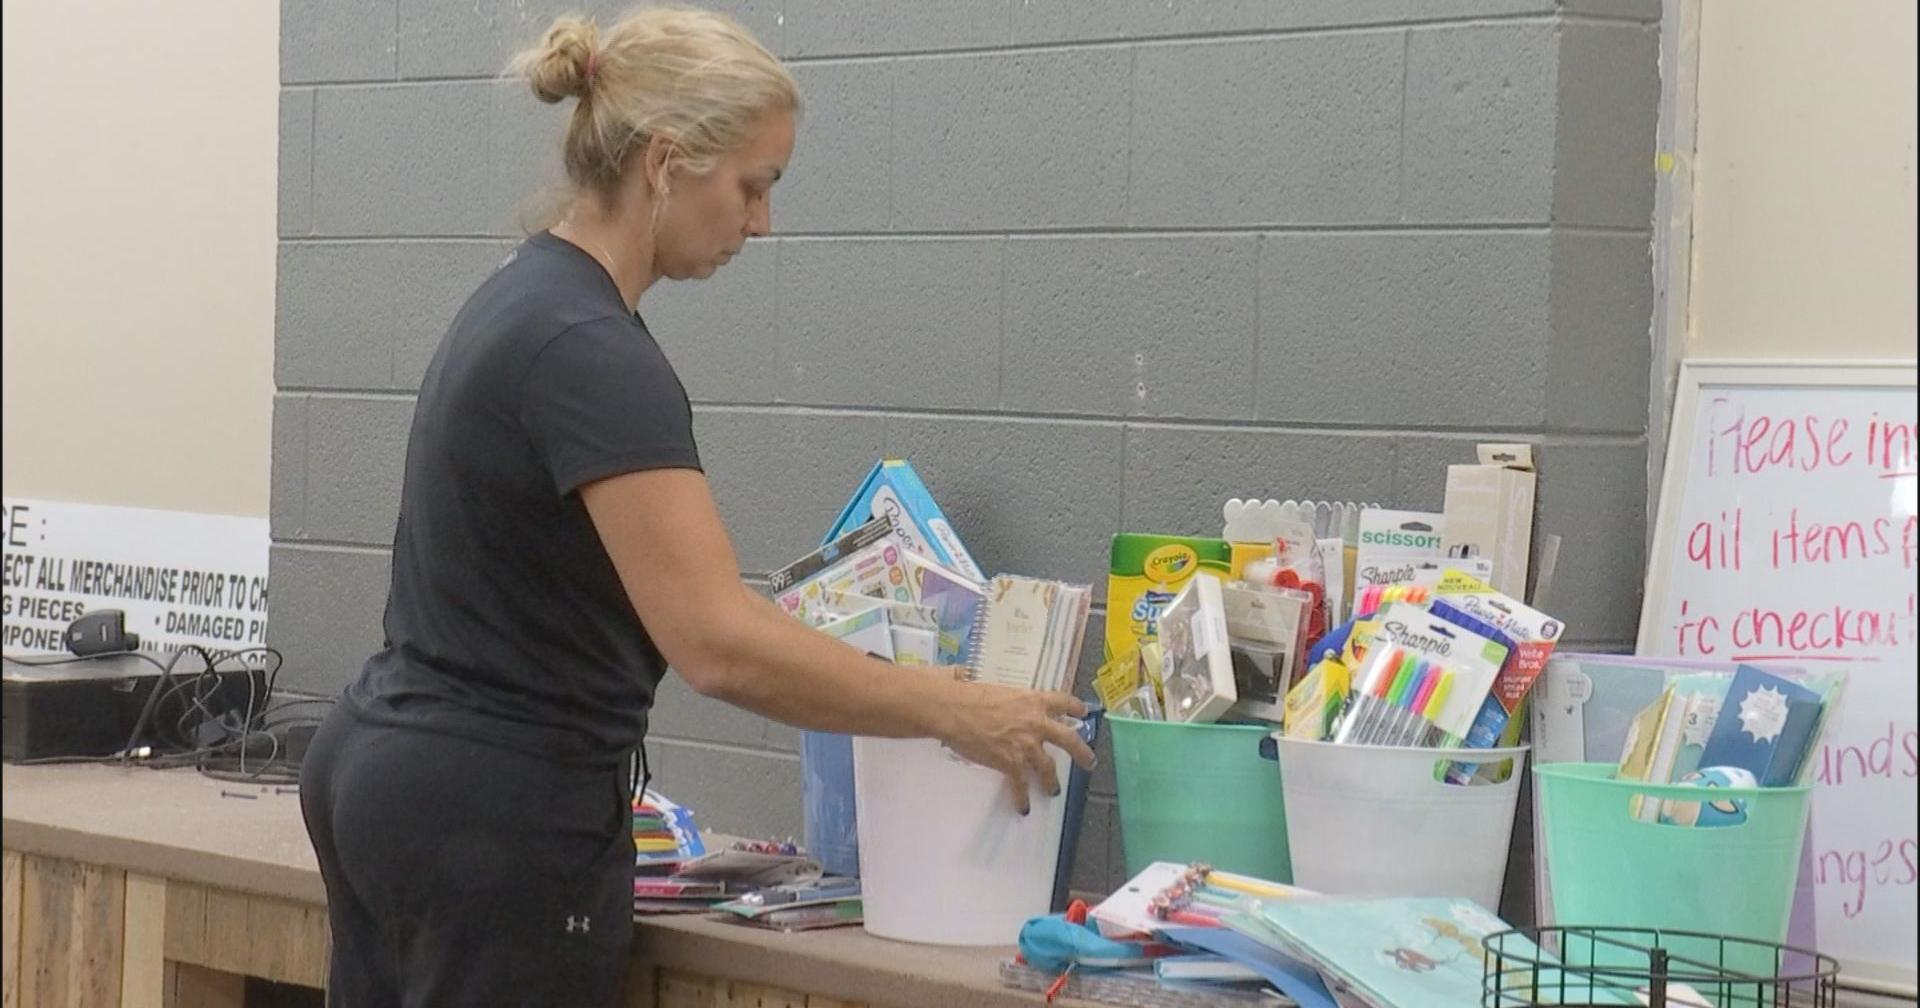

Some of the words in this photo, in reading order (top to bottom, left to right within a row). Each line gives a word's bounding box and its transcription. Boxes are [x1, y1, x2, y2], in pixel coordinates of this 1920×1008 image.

[1866, 411, 1918, 470] in
[36, 556, 65, 592] ALL
[69, 558, 179, 602] MERCHANDISE
[180, 570, 225, 607] PRIOR
[228, 573, 247, 611] TO
[1150, 552, 1192, 569] Crayola
[1361, 563, 1417, 586] Sharpie
[19, 596, 85, 623] PIECES
[165, 611, 245, 641] DAMAGED
[248, 620, 267, 644] PI
[1374, 620, 1451, 658] Sharpie
[1816, 838, 1918, 919] nges
